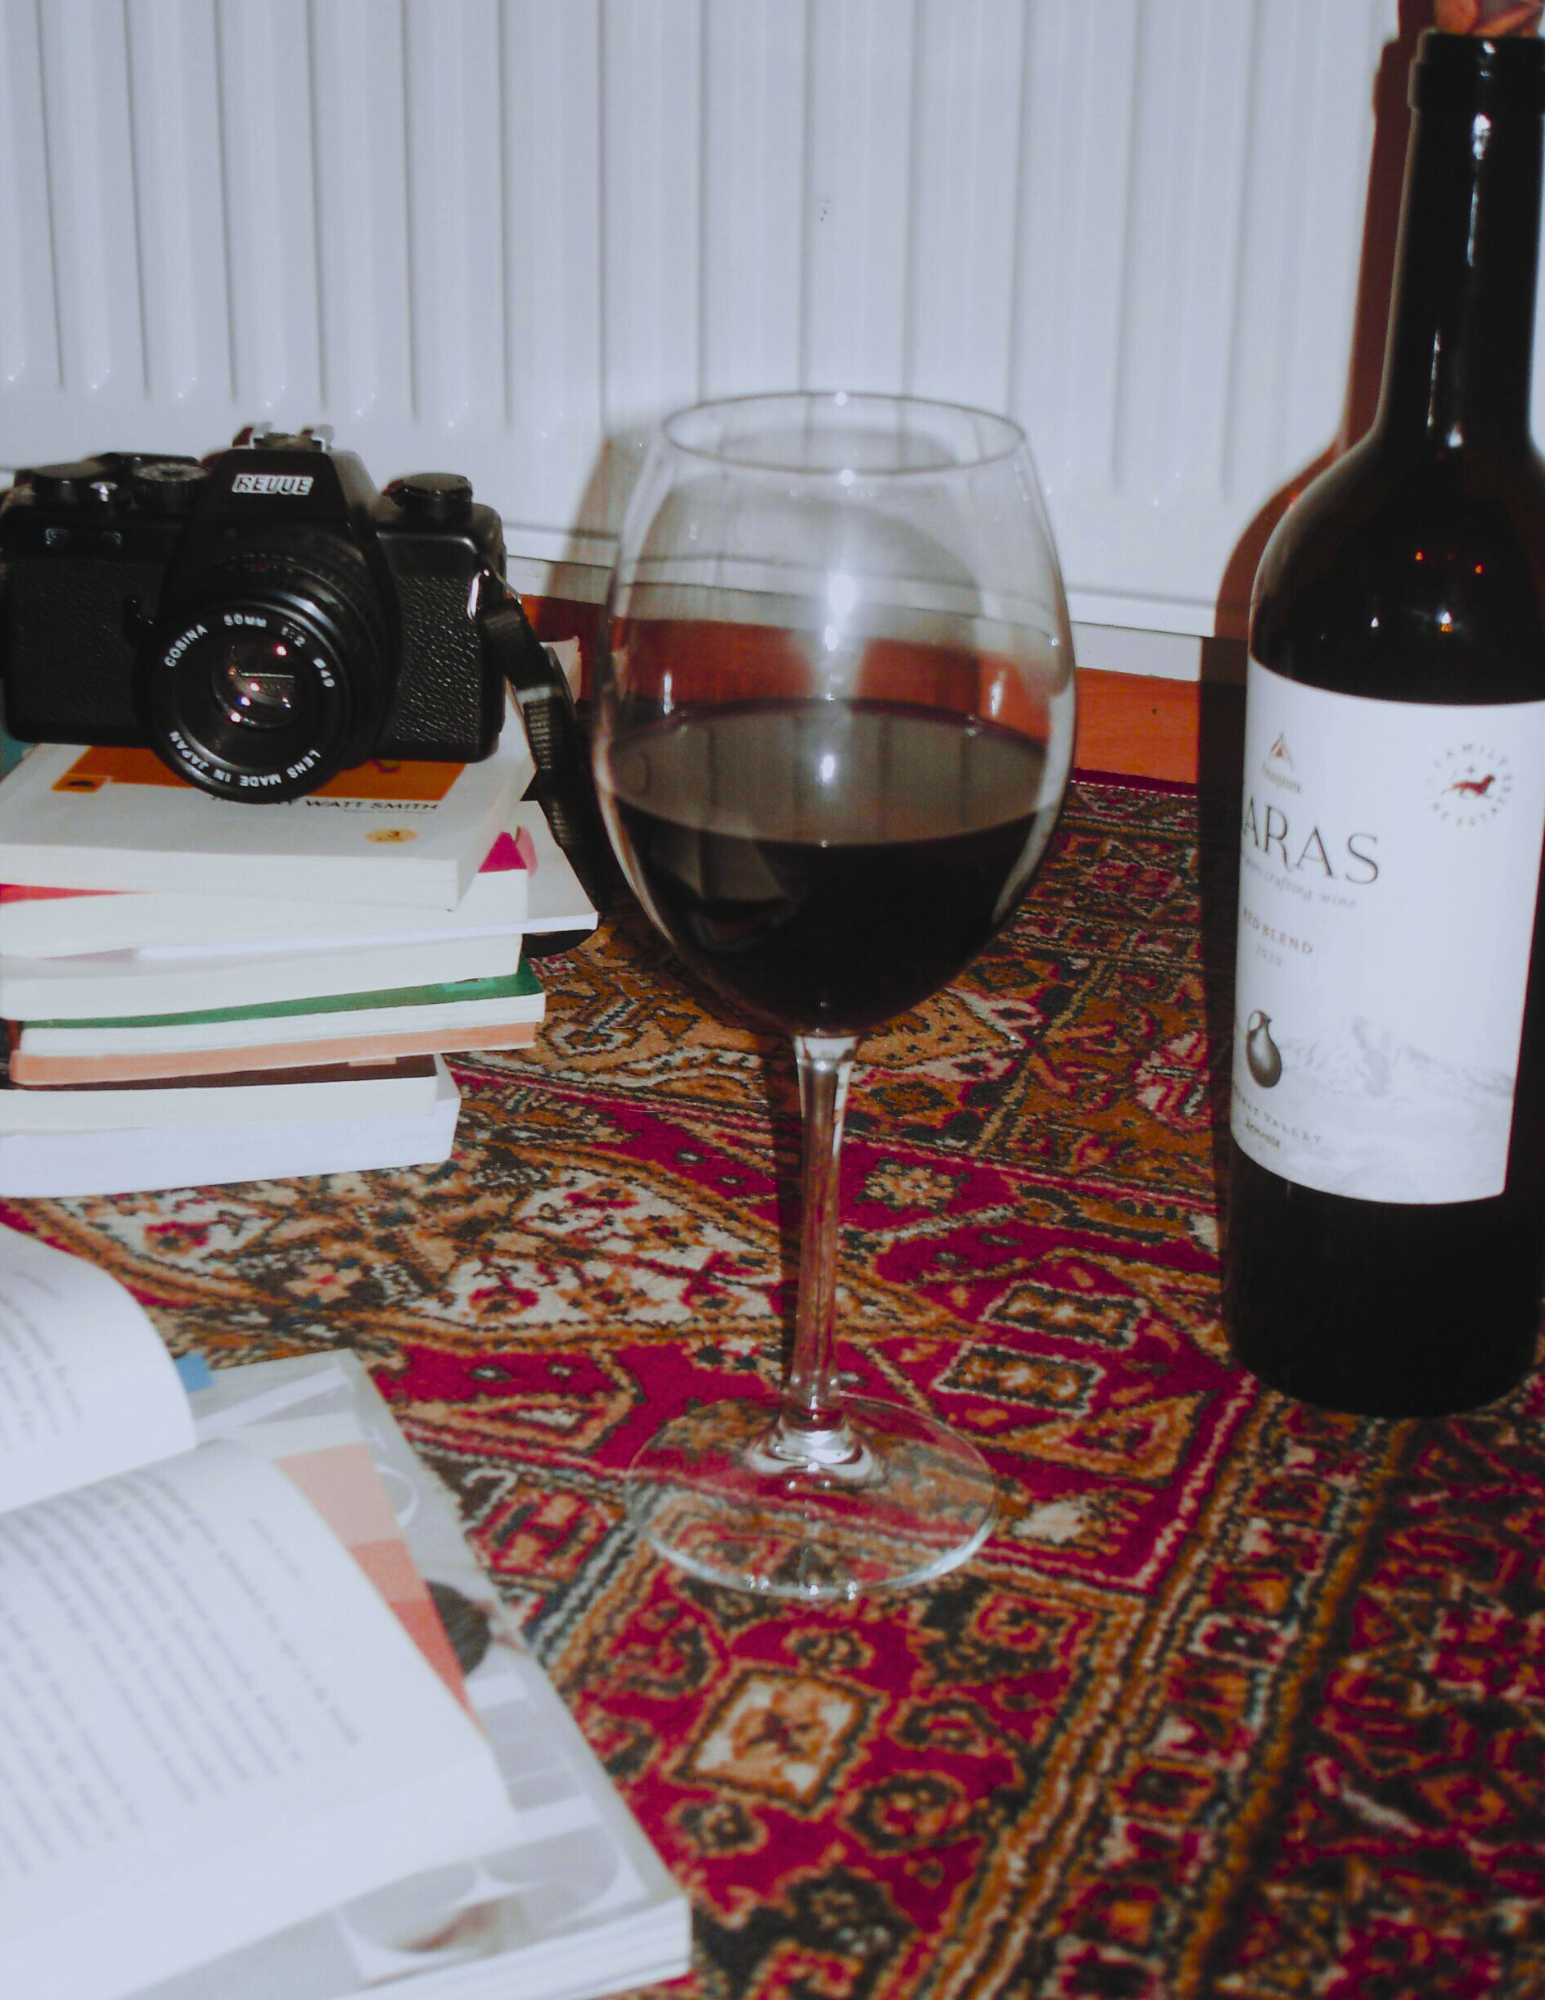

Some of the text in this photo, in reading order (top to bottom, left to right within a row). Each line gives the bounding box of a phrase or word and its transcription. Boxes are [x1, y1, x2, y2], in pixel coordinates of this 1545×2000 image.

[231, 473, 314, 495] REVUE
[164, 624, 208, 667] COSINA
[169, 731, 321, 788] LENS MADE IN JAPAN
[305, 800, 438, 810] WATT SMITH
[1262, 921, 1313, 954] BLEND
